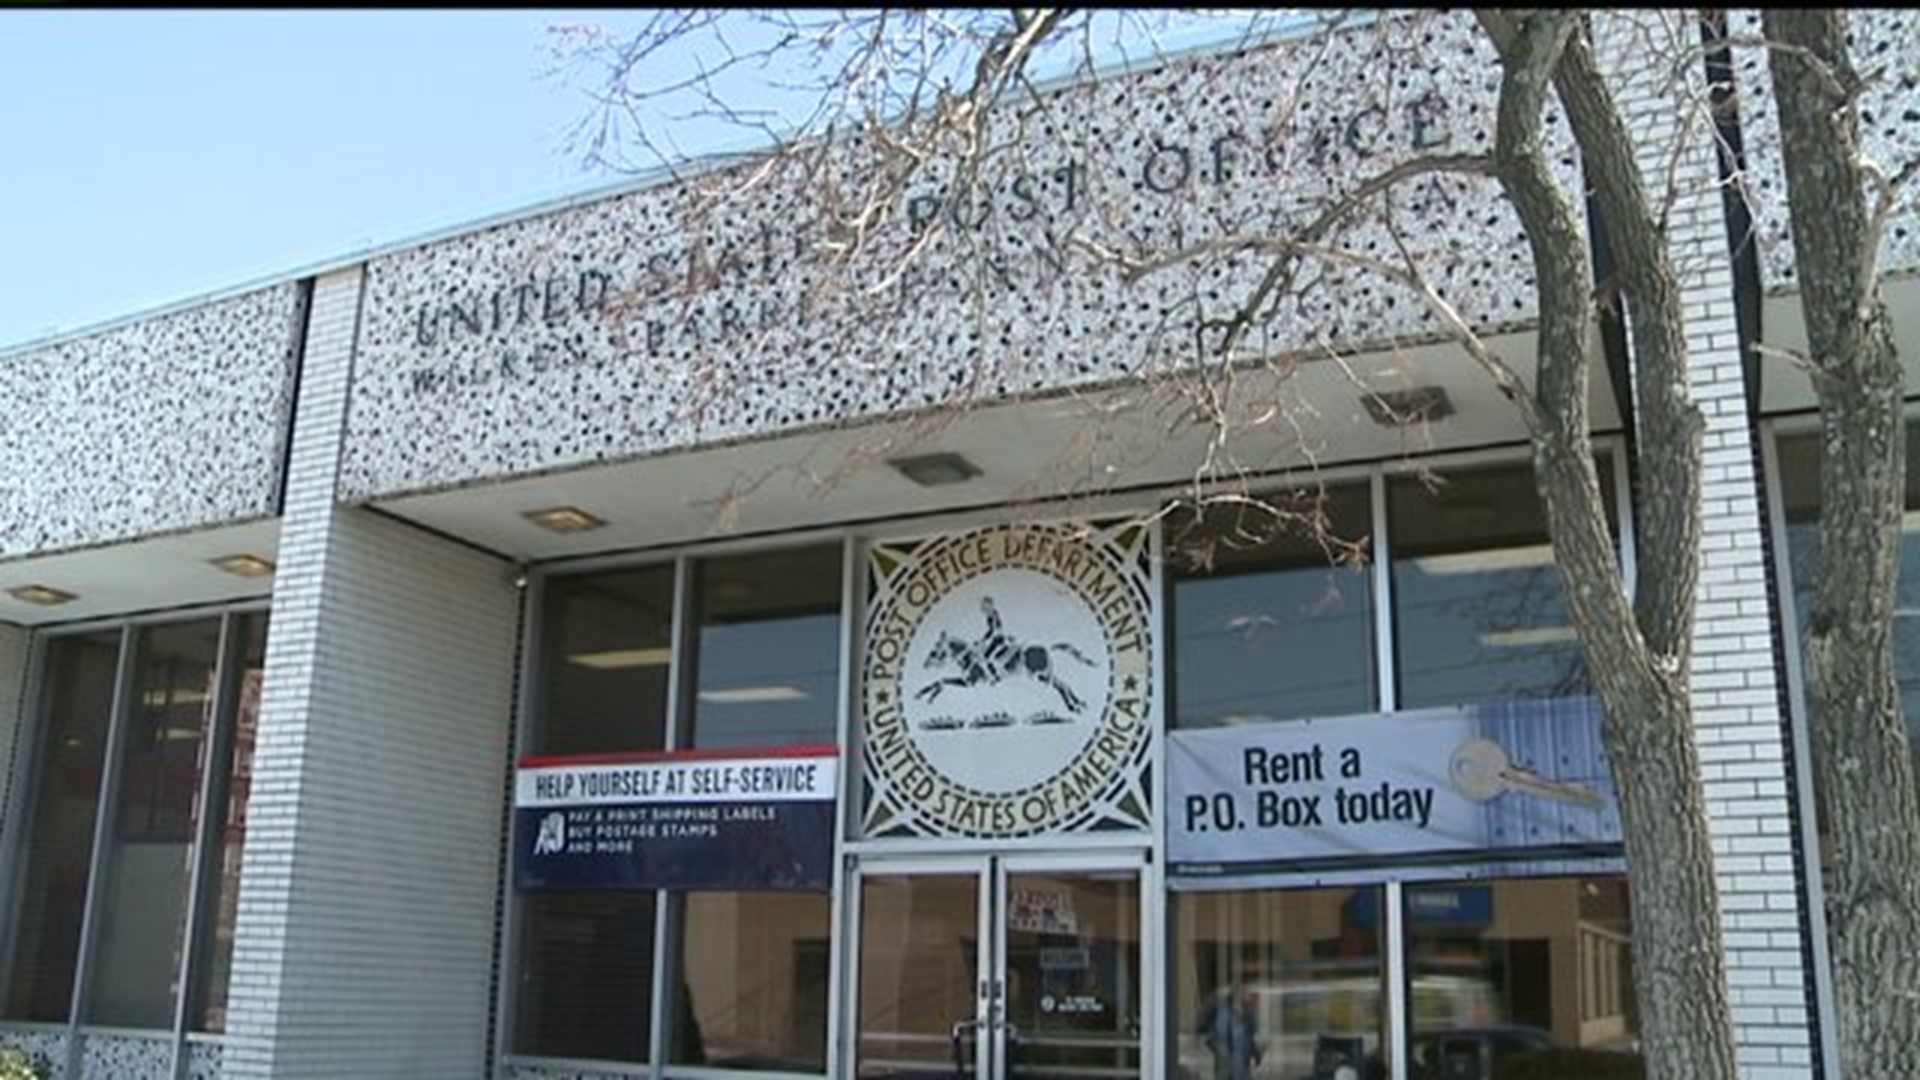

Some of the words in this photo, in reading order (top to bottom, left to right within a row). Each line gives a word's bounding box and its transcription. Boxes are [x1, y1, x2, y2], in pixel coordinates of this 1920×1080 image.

[415, 268, 612, 347] UNITED
[645, 200, 855, 297] STAT
[906, 156, 1083, 233] POST
[1143, 96, 1451, 192] OFICE
[411, 337, 588, 394] WILKES
[872, 611, 913, 681] POST
[906, 537, 992, 607] OFFICE
[1003, 532, 1143, 653] DEPARTMENT
[536, 775, 574, 799] HELP
[578, 769, 662, 797] YOURSELF
[664, 768, 686, 795] AT
[691, 763, 818, 794] SELF-SERVICE
[873, 705, 935, 801] UNITED
[932, 790, 1014, 831] STATES
[1021, 794, 1059, 825] OF
[1061, 697, 1141, 802] AMERICA
[1243, 743, 1324, 786] Rent
[1339, 747, 1362, 778] a
[568, 811, 591, 823] PAY
[608, 809, 647, 822] PRINT
[652, 807, 719, 821] SHIPPING
[723, 805, 776, 820] LABELS
[1185, 793, 1246, 832] P.O.
[1256, 790, 1323, 829] Box
[1335, 782, 1434, 829] today
[568, 826, 592, 838] BUY
[596, 824, 656, 838] POSTAGE
[661, 823, 719, 837] STAMPS
[568, 842, 593, 853] AND
[596, 840, 634, 854] MORE
